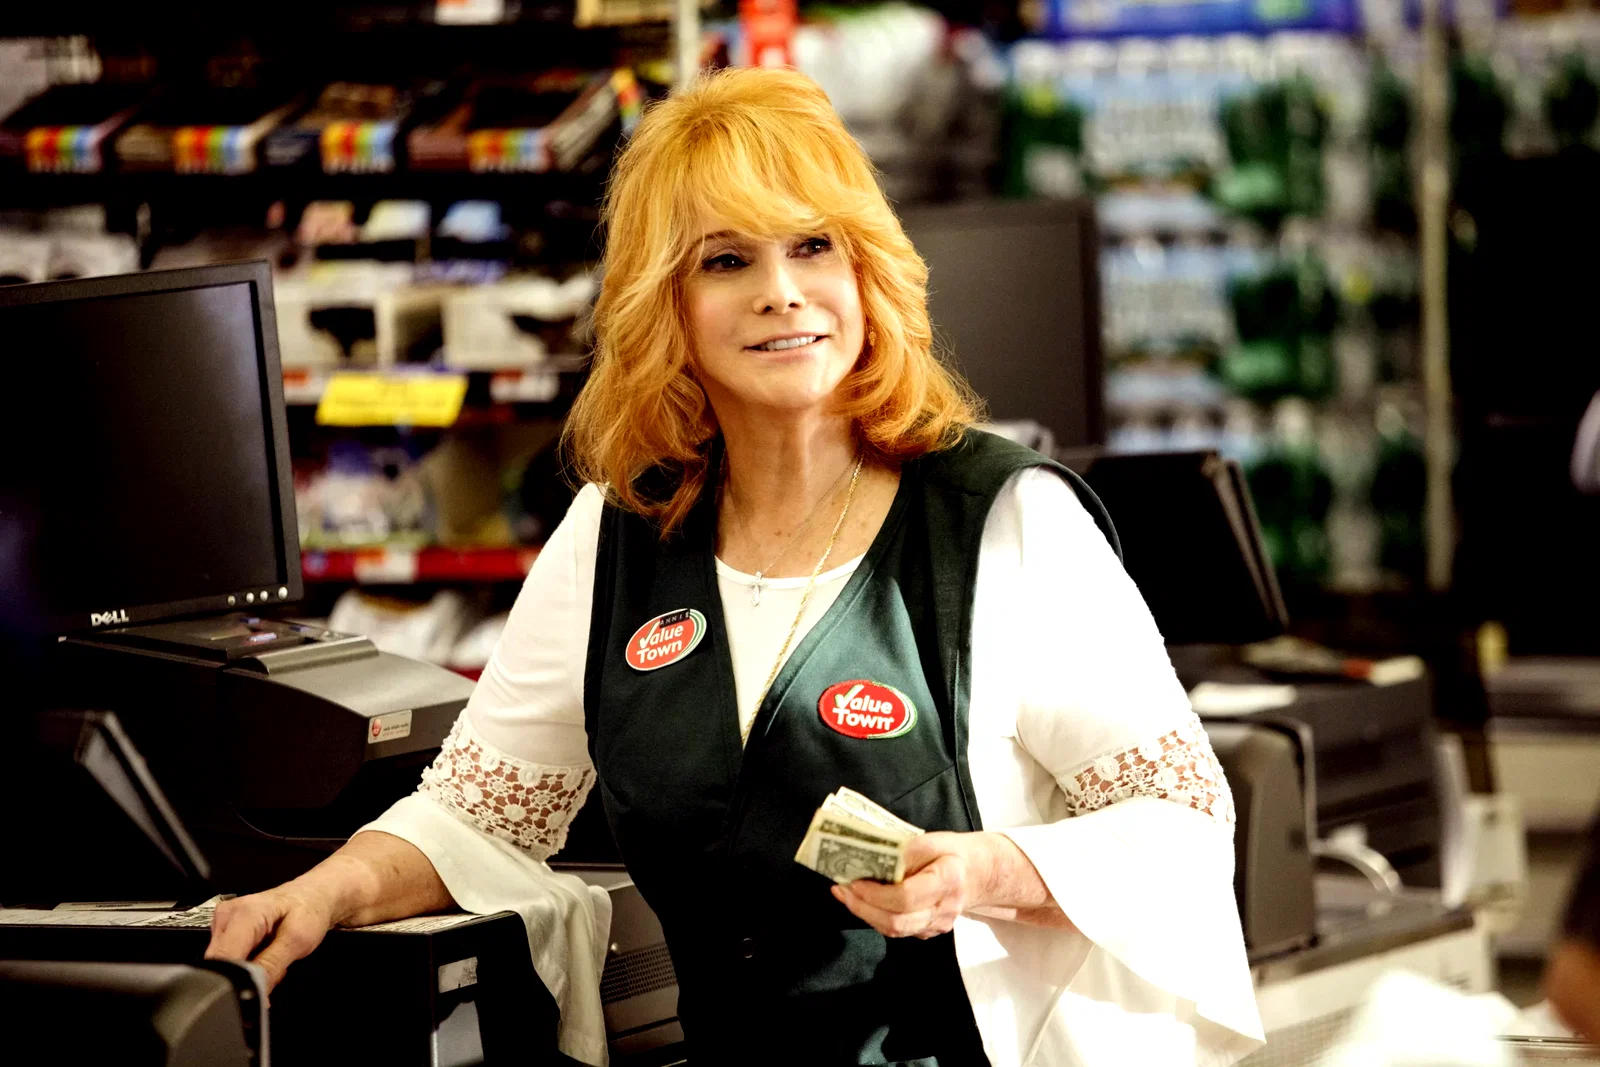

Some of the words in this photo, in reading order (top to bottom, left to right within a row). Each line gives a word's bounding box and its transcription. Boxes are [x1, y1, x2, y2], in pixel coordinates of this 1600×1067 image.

[91, 609, 129, 627] DELL
[660, 611, 689, 625] ANNIE
[639, 620, 684, 649] Value
[637, 640, 682, 663] Town
[835, 684, 893, 714] Value
[832, 707, 894, 730] Town
